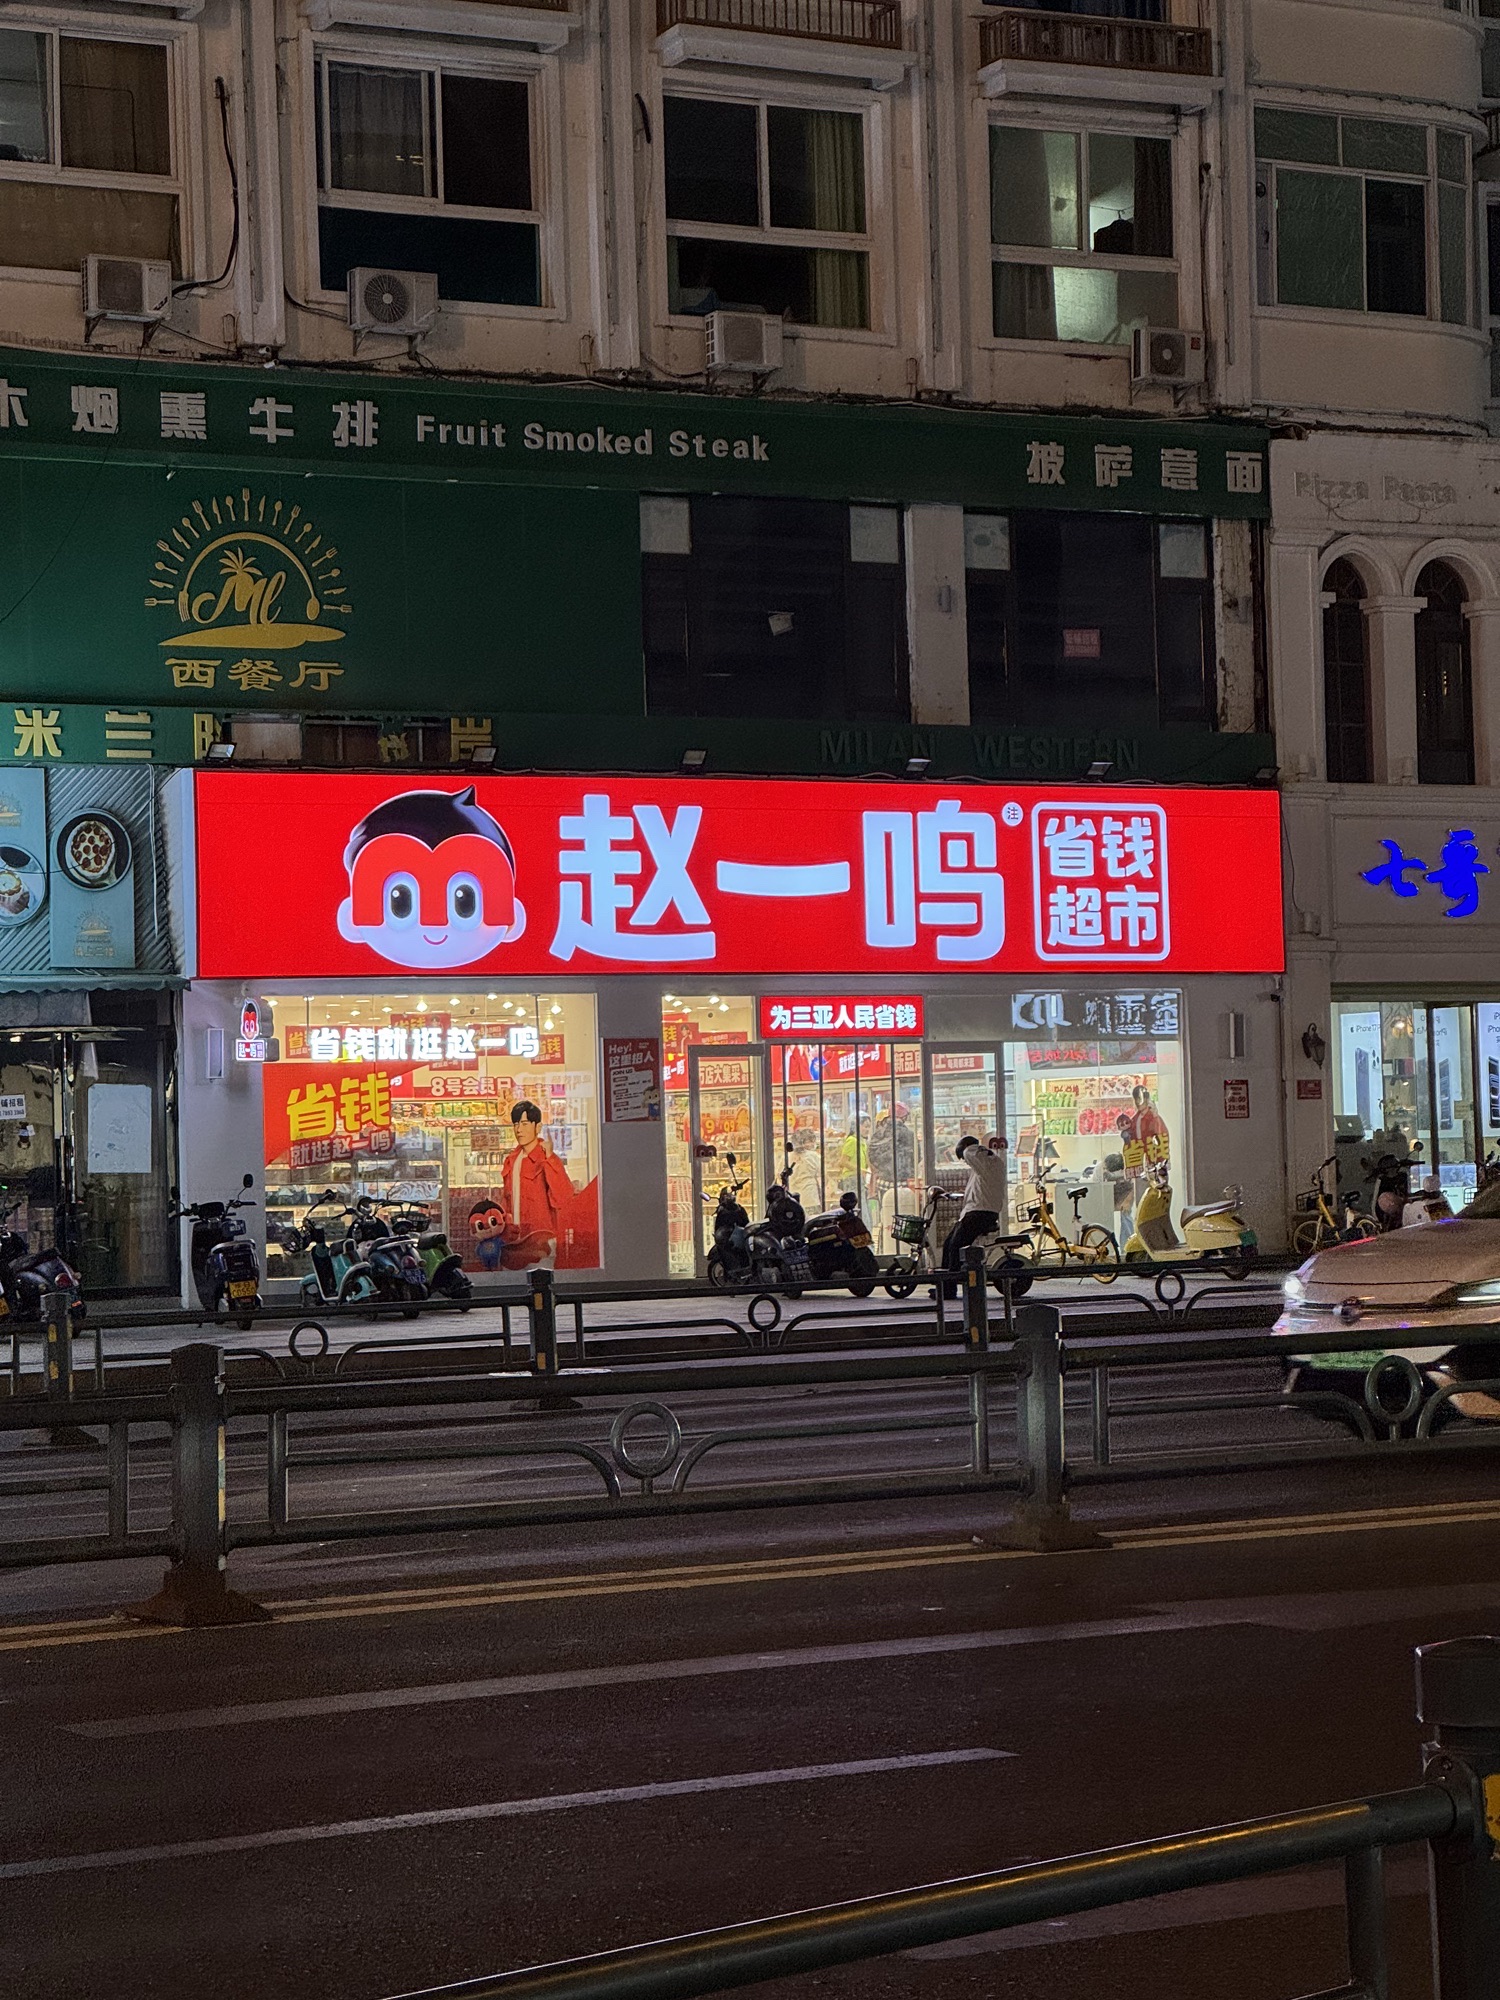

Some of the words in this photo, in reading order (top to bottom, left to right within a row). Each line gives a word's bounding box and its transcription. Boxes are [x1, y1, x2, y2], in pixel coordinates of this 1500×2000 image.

[416, 414, 506, 448] Fruit
[523, 422, 653, 456] Smoked
[668, 430, 770, 461] Steak
[1026, 440, 1263, 494] 披萨意面
[1292, 471, 1370, 501] Pizza
[1382, 474, 1458, 505] Pasta
[164, 657, 345, 692] 西餐厅
[819, 730, 932, 765] MILAN
[1044, 815, 1155, 878] 省钱
[548, 793, 1006, 962] 赵一鸣
[1047, 884, 1160, 948] 超市
[769, 1004, 917, 1030] 为三亚人民省钱
[309, 1026, 540, 1061] 省钱就逛赵一鸣
[608, 1042, 632, 1055] Hey!
[286, 1071, 391, 1142] 省钱
[290, 1130, 391, 1167] 就逛赵一鸣
